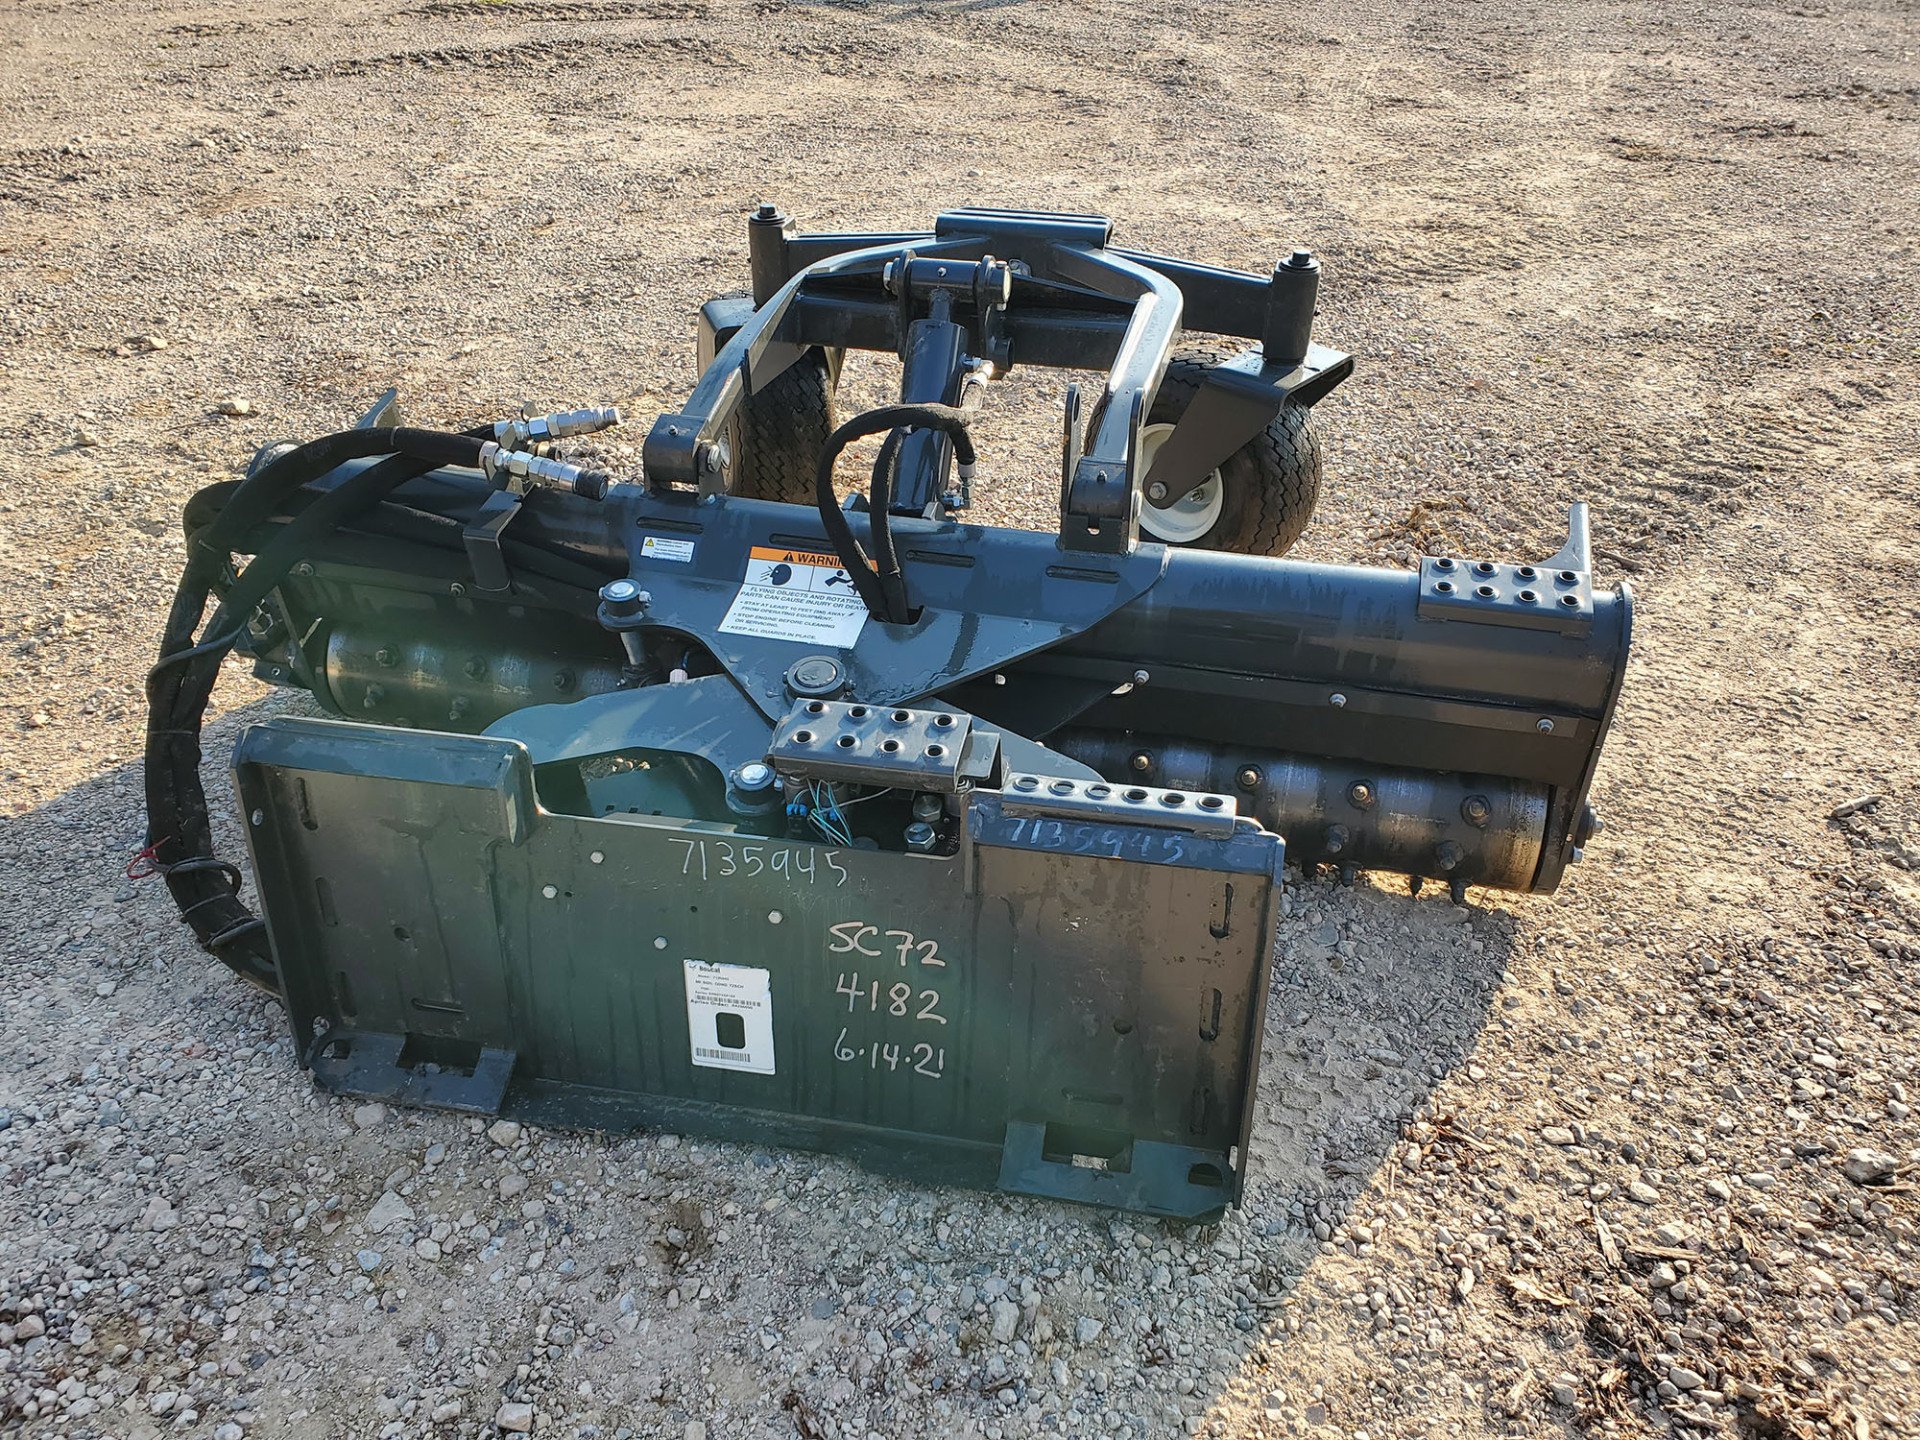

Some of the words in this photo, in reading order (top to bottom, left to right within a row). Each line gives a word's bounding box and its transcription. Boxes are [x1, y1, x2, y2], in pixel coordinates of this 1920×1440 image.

[797, 553, 845, 567] WARNI
[750, 586, 775, 594] FLYING
[776, 589, 808, 598] OBJECTS
[826, 596, 862, 605] ROTATING
[764, 593, 779, 601] CAN
[780, 596, 804, 604] CAUSE
[805, 599, 832, 607] INJURY
[760, 608, 796, 617] OPERATING
[796, 612, 833, 621] EQUIPMENT.
[745, 619, 778, 628] SERVICING.
[778, 617, 804, 625] BEFORE
[804, 621, 836, 629] CLEANING
[668, 838, 847, 887] 7135945
[836, 972, 947, 1024] 4182
